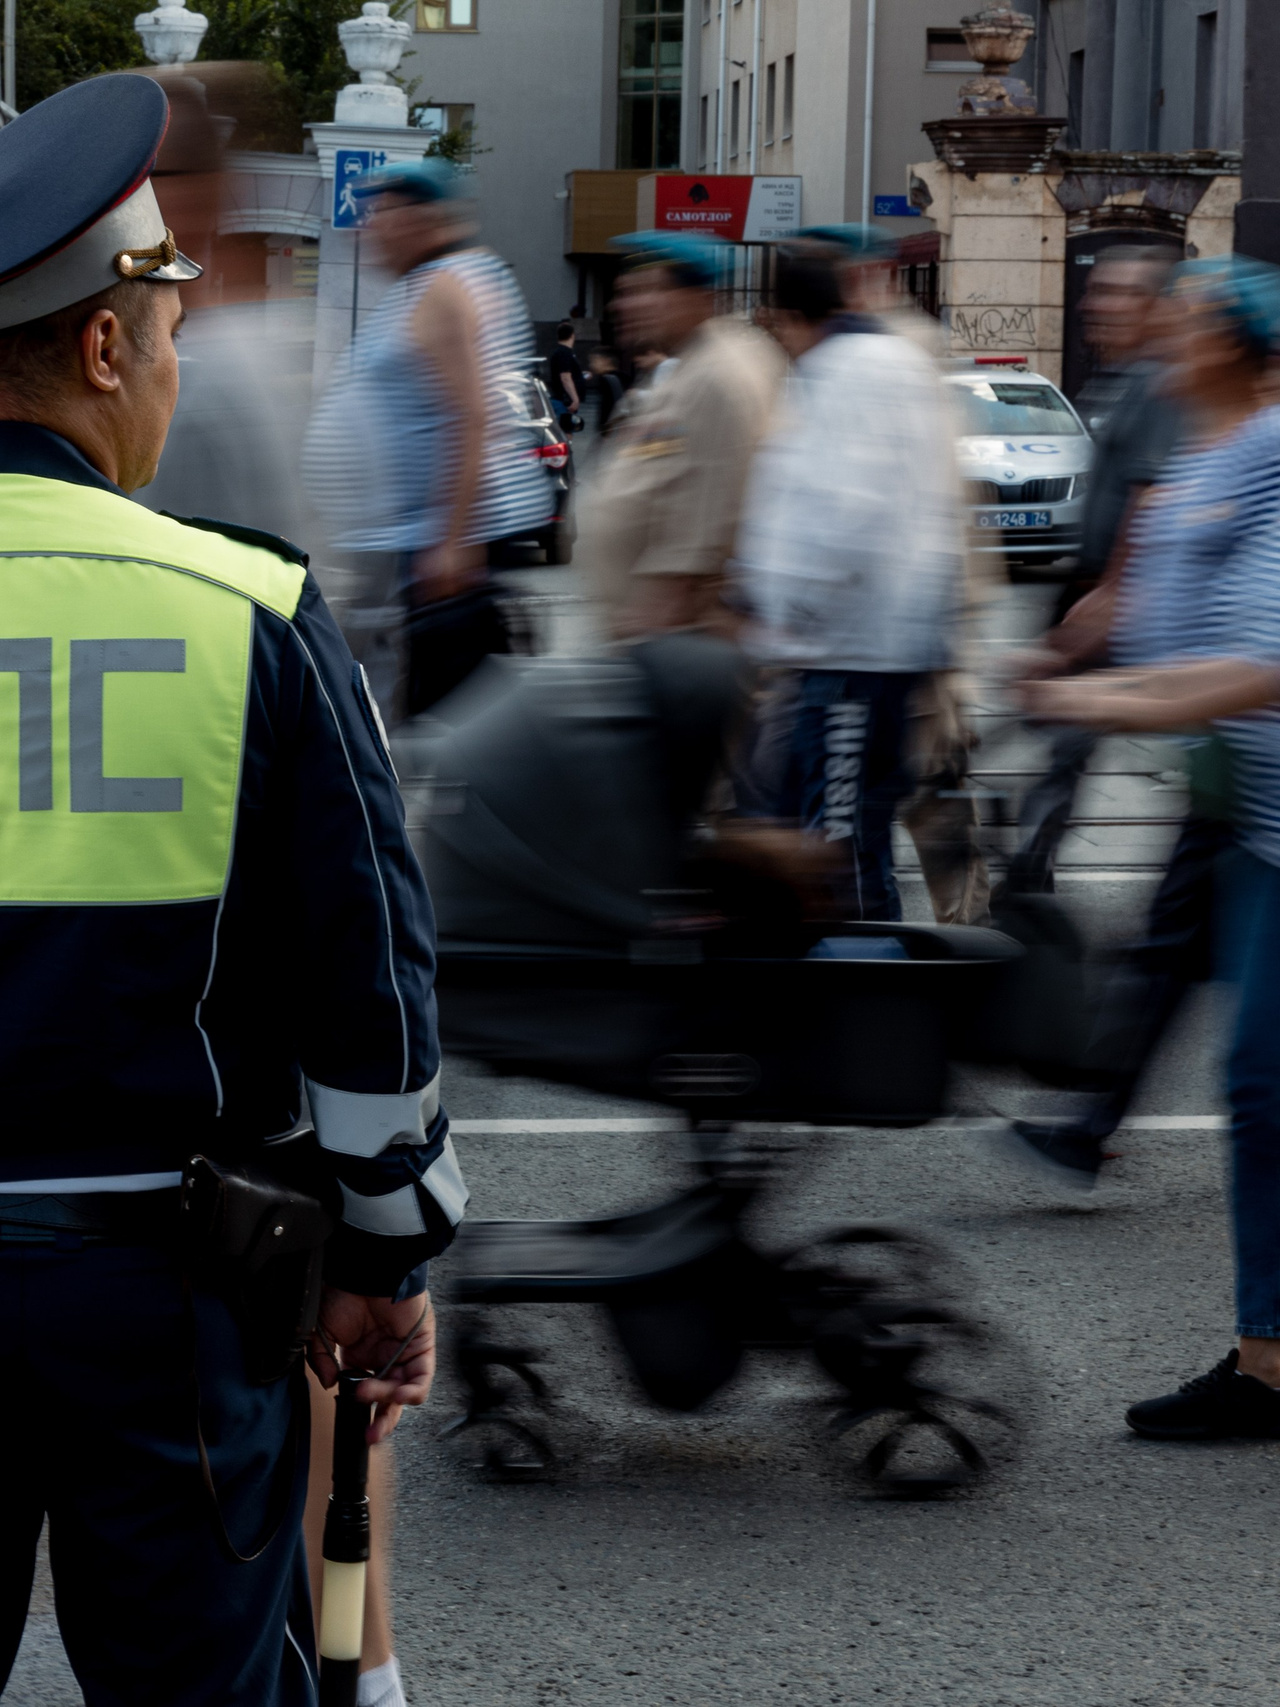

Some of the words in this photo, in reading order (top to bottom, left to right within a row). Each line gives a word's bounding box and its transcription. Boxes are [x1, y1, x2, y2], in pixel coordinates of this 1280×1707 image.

[666, 212, 732, 221] САМОТЛОР
[994, 513, 1026, 526] 1248
[1034, 512, 1047, 522] 74
